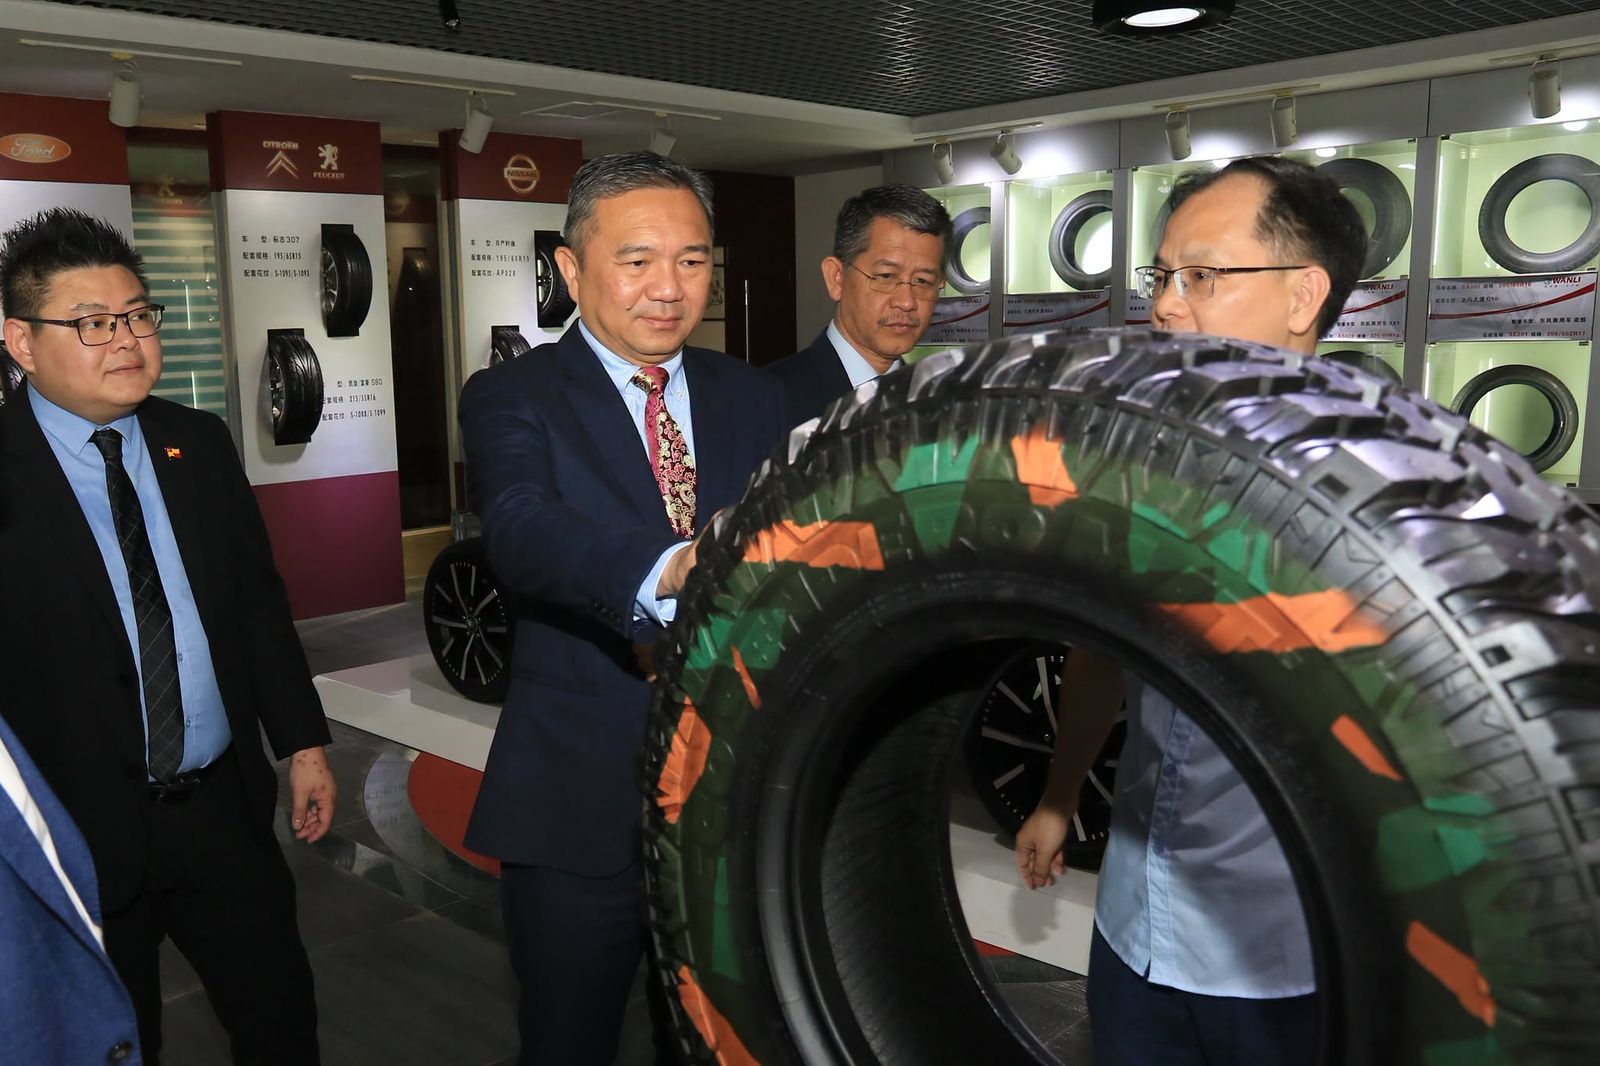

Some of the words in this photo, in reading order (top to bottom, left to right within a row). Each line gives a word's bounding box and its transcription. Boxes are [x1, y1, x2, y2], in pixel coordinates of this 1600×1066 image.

[11, 138, 56, 158] Ford
[313, 171, 345, 179] PEUGEOT
[1552, 276, 1581, 284] WANLI
[1370, 283, 1394, 291] WANLI
